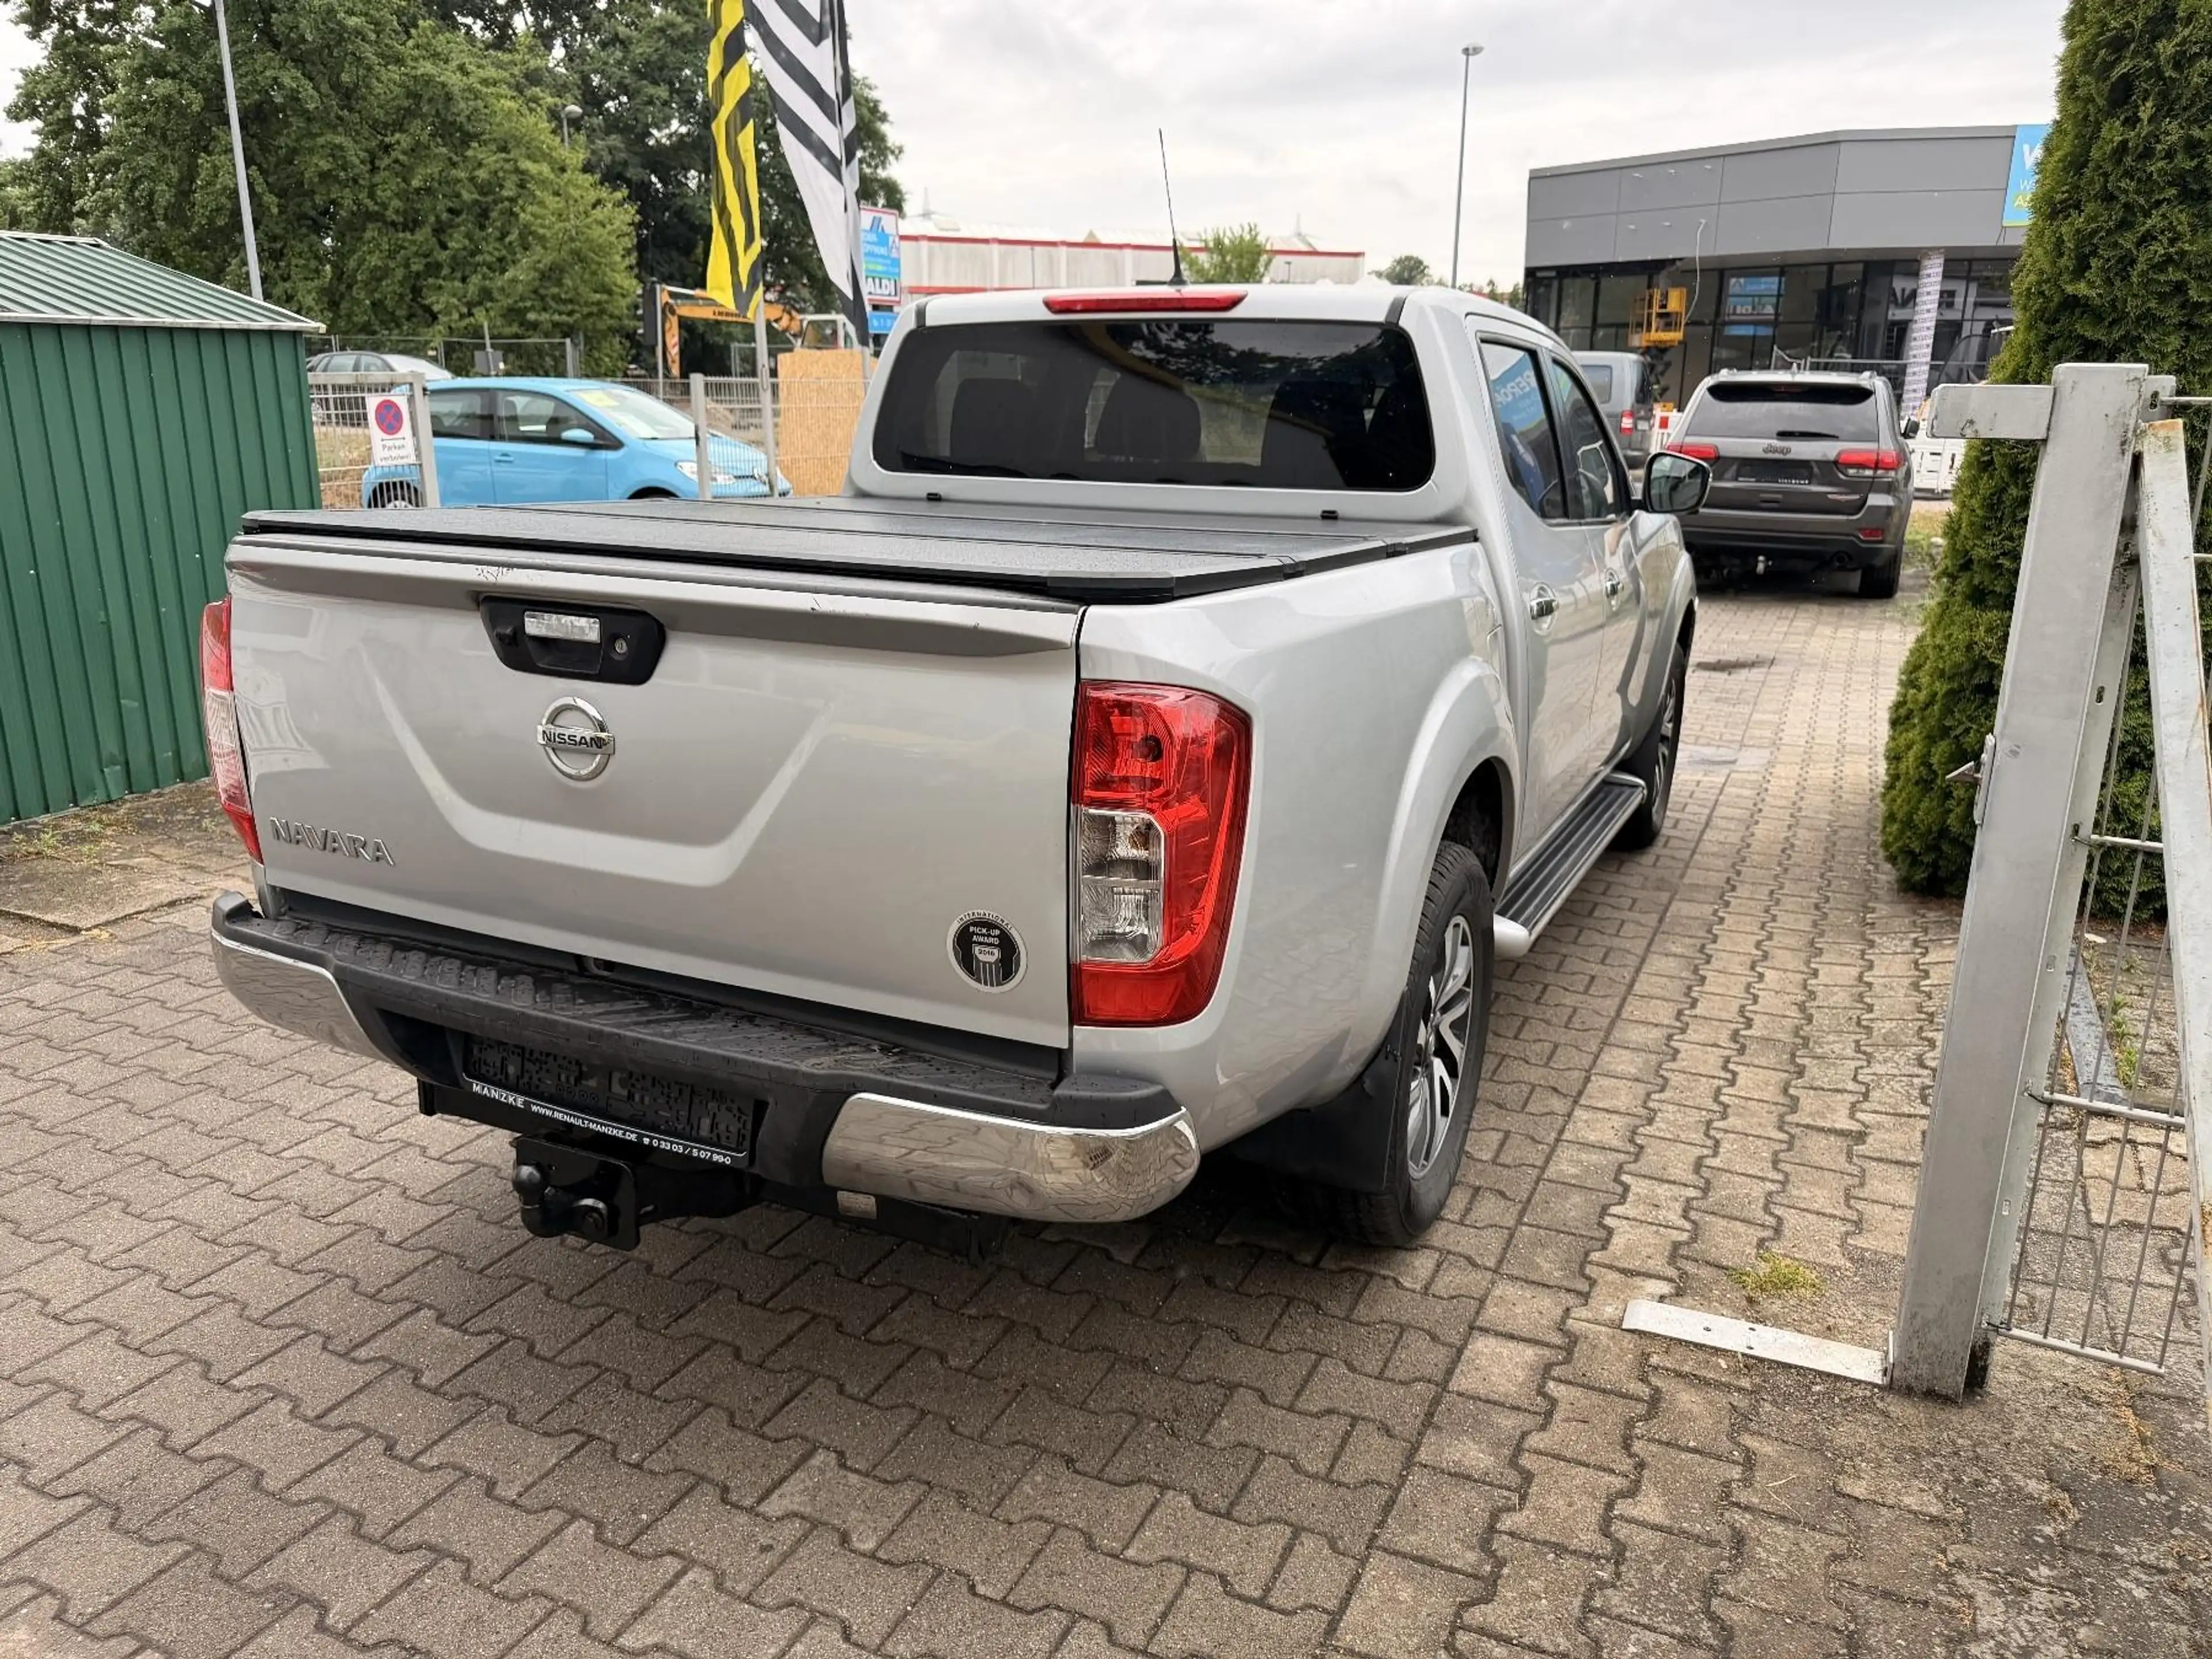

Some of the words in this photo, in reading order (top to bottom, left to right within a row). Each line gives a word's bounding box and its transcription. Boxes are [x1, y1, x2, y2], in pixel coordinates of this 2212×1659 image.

[866, 277, 896, 296] ALDI
[1762, 442, 1791, 456] Jeep
[541, 729, 604, 749] NISSAN
[270, 816, 396, 866] NAVARA
[957, 911, 1013, 931] INTERNATIONAL
[969, 925, 1001, 935] PICK-UP
[972, 935, 1000, 945] AWARD
[978, 948, 995, 956] 2016
[472, 1082, 525, 1108] MANZKE
[531, 1103, 638, 1142] WWW.RENAULT-MANZKE.DE
